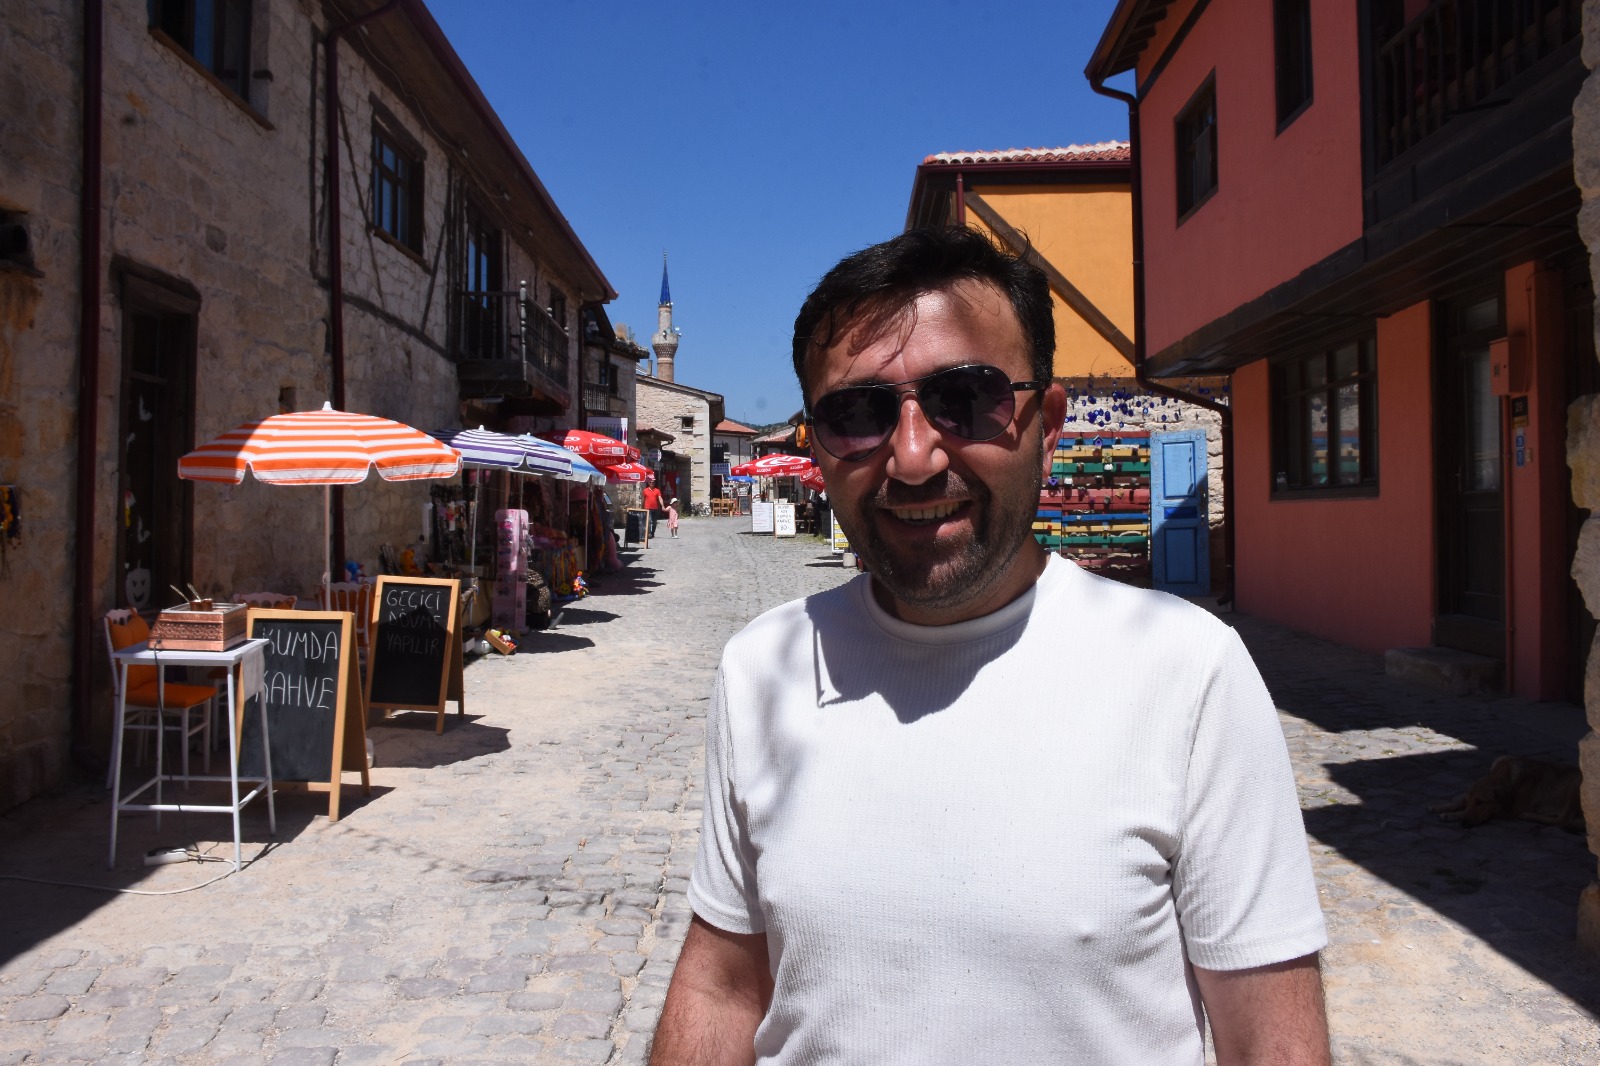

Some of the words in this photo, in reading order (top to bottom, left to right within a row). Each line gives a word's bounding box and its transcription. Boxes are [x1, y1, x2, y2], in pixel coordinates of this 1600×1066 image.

[388, 608, 441, 630] DÖVME
[262, 627, 338, 663] KUMDA
[386, 633, 440, 655] YAPILIR
